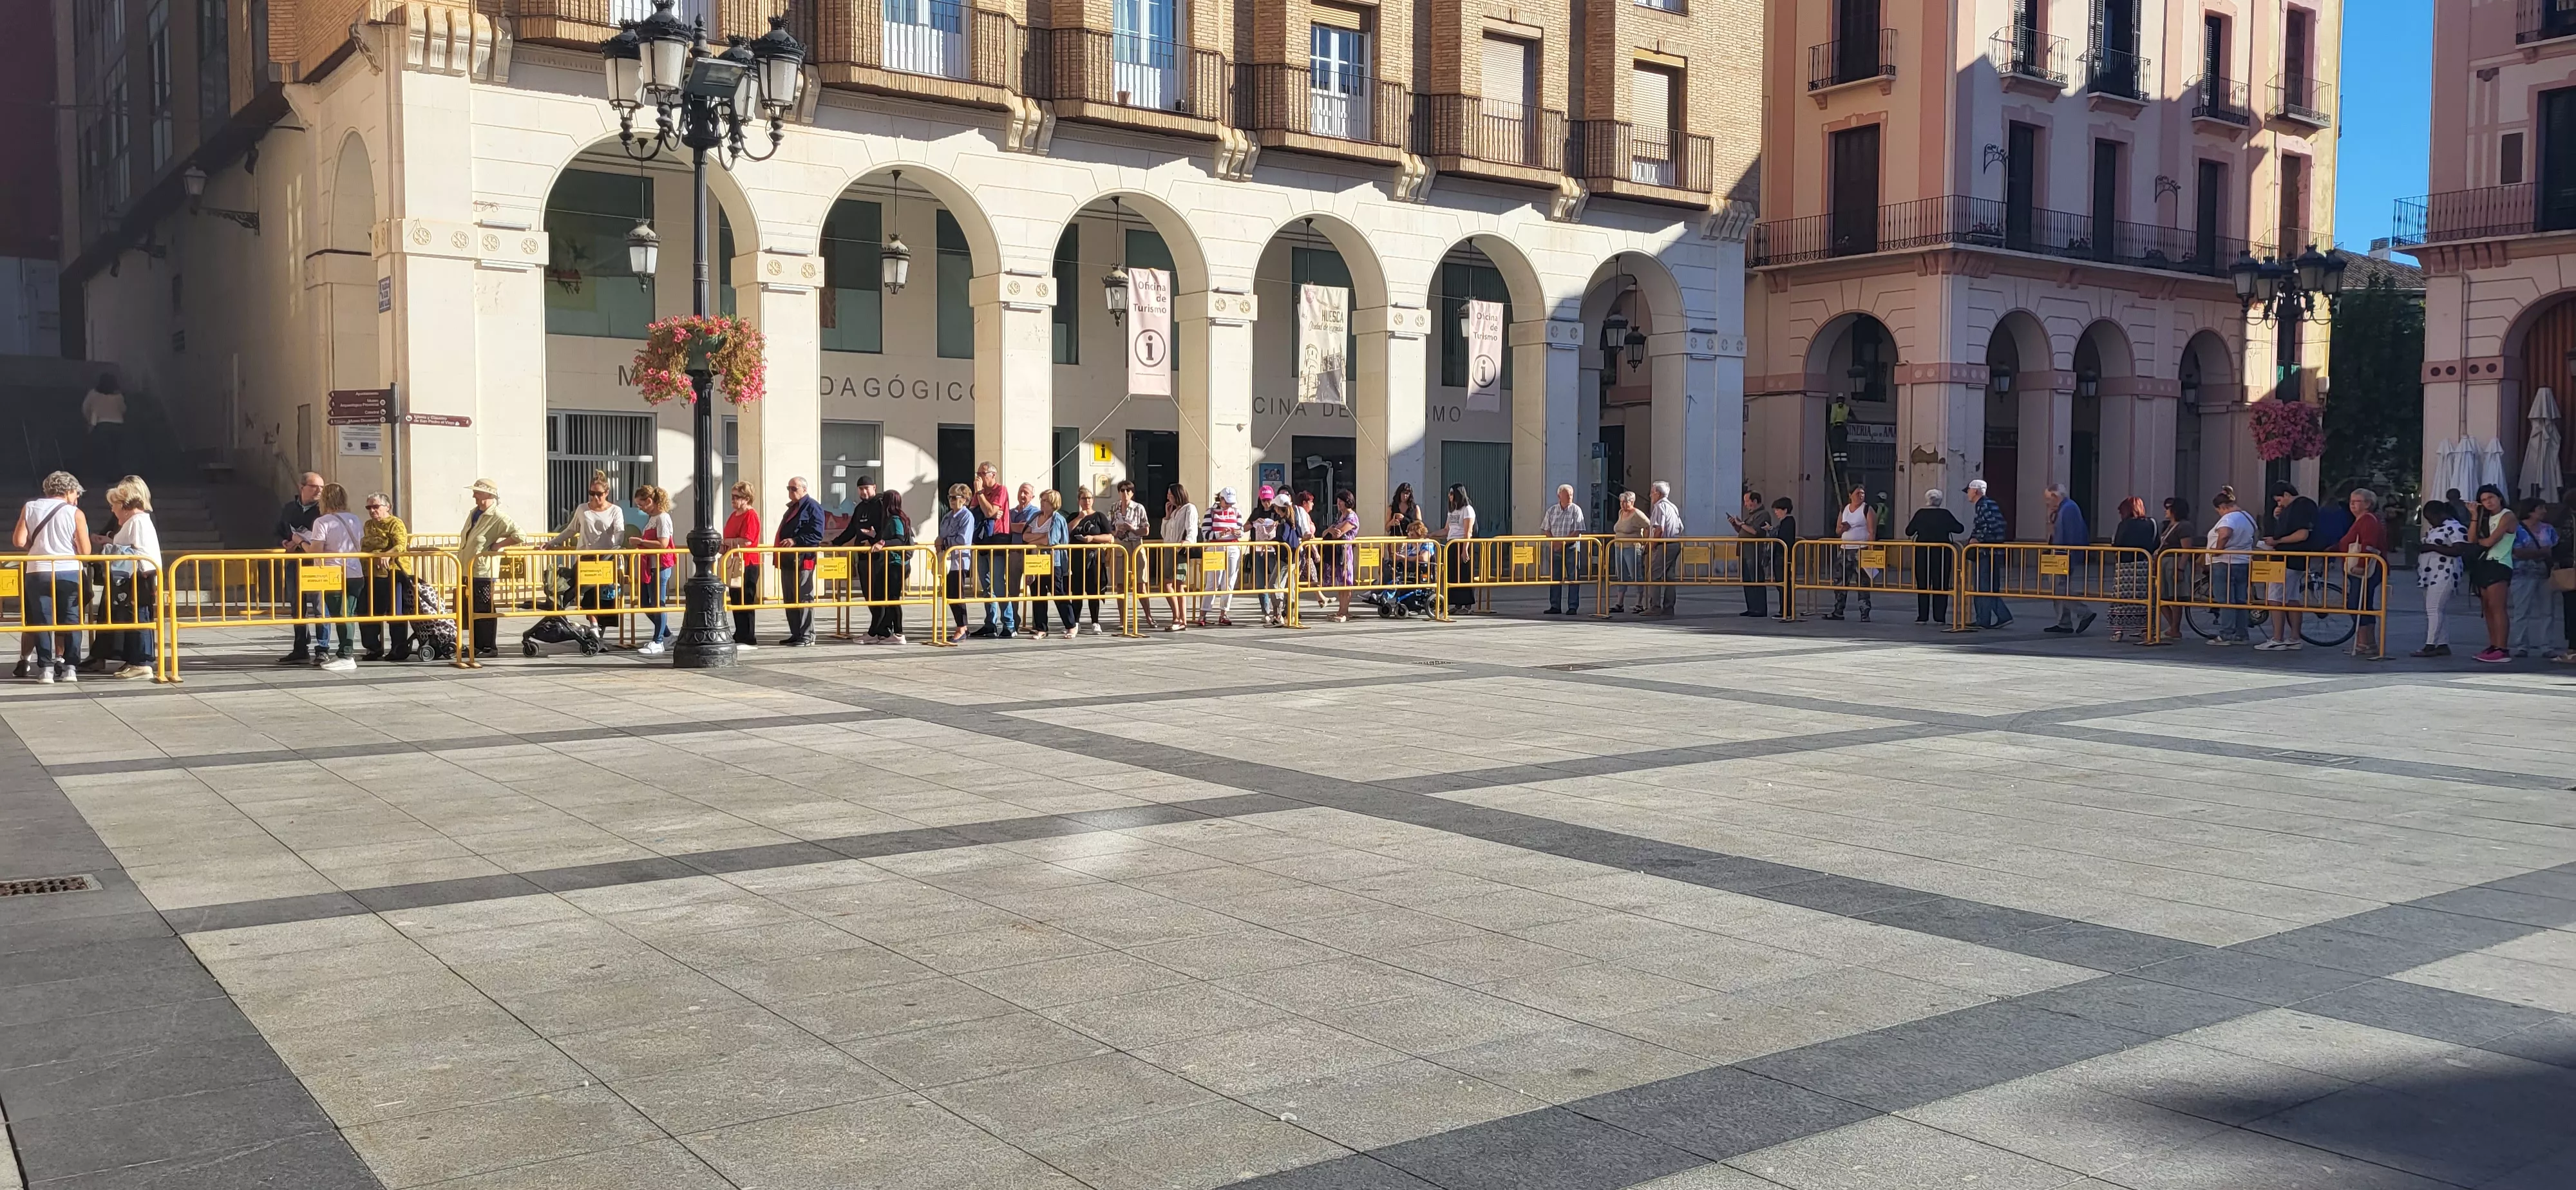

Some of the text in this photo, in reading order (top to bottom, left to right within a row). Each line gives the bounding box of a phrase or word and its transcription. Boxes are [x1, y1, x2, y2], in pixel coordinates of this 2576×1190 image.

[1138, 281, 1166, 292] Oficina
[1156, 294, 1166, 302] de
[1133, 303, 1166, 314] Turismo
[1321, 309, 1343, 323] HUESCA
[1476, 312, 1498, 321] Oficina
[1473, 332, 1498, 341] Turismo
[820, 374, 975, 402] DAGÓGIC
[1253, 396, 1349, 418] CINA DE
